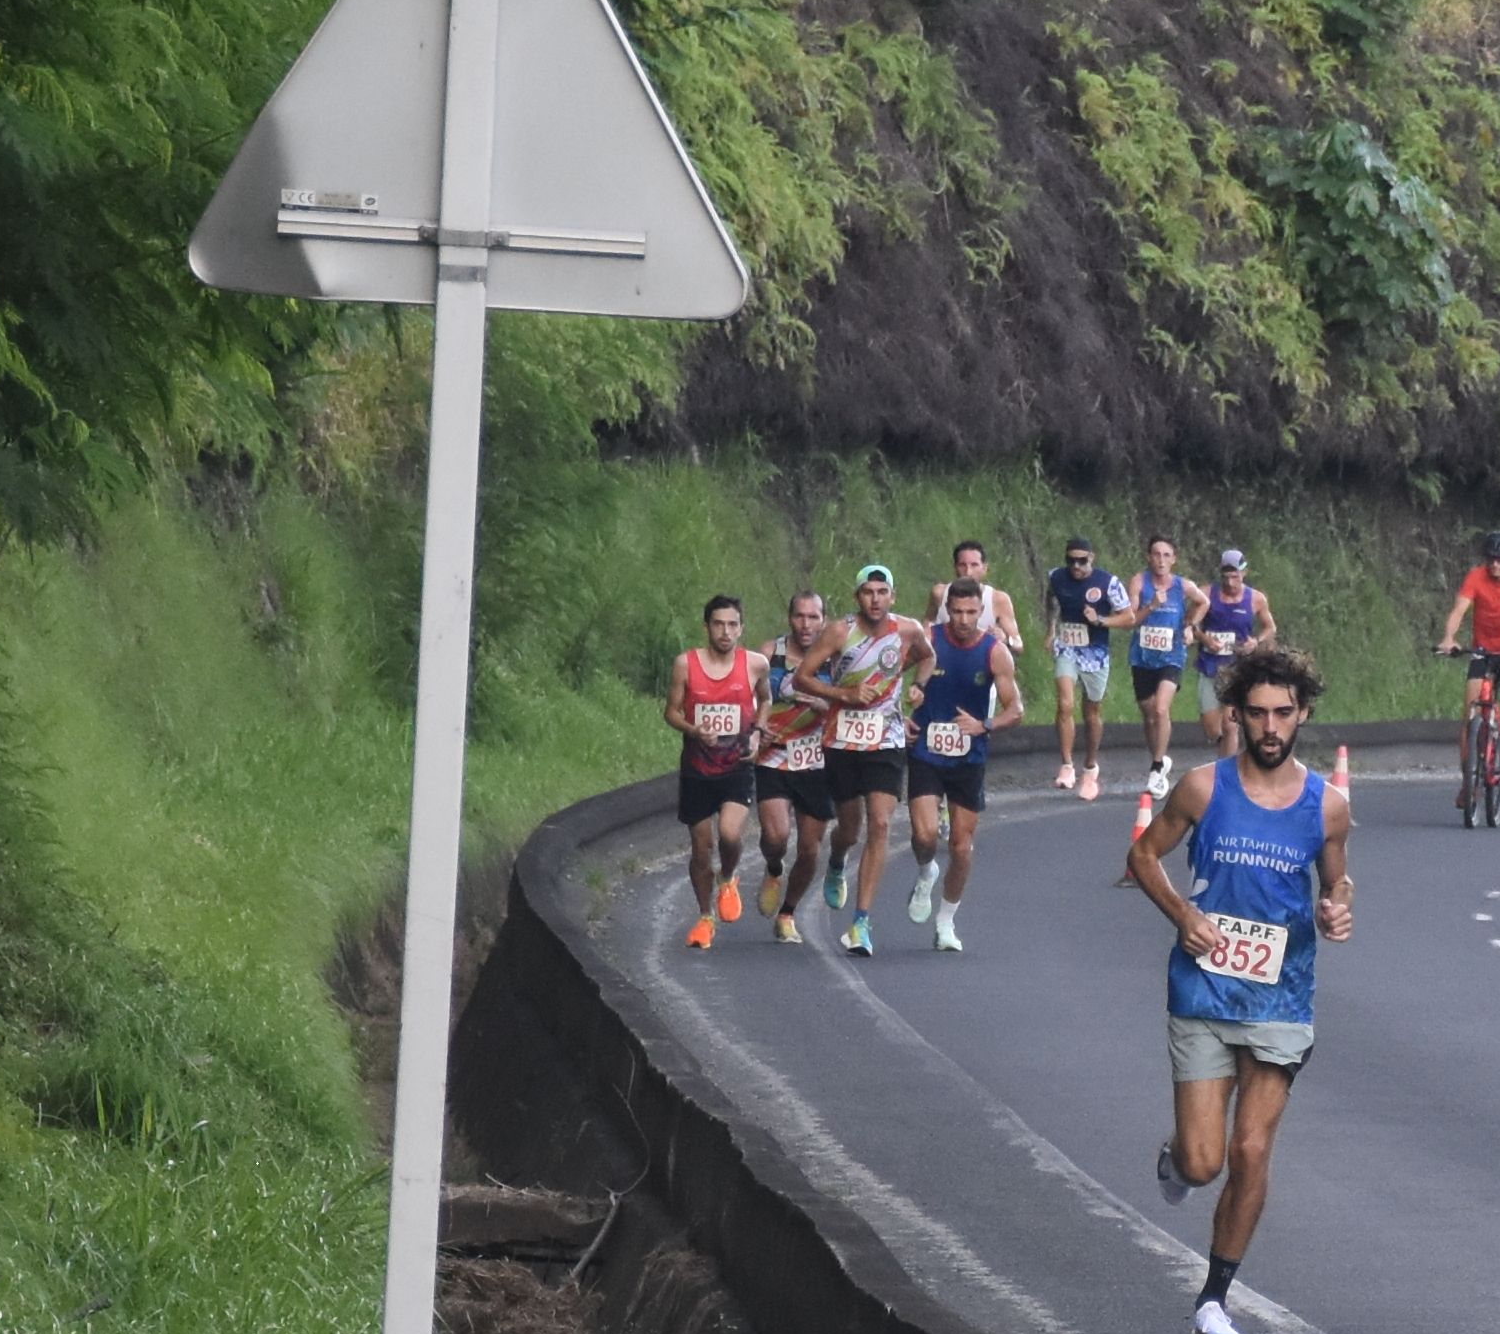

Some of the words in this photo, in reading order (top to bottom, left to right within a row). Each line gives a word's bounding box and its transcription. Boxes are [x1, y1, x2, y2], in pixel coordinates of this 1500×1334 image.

[1063, 630, 1082, 644] 811
[1144, 634, 1167, 648] 960
[844, 720, 876, 740] 795
[934, 733, 964, 753] 894
[1215, 835, 1238, 848] AIR
[1240, 837, 1281, 855] TAHITI
[1284, 846, 1307, 861] NUI
[1213, 850, 1302, 874] RUNNING
[1217, 917, 1277, 941] F.A.P.F.
[1209, 934, 1272, 977] 852
